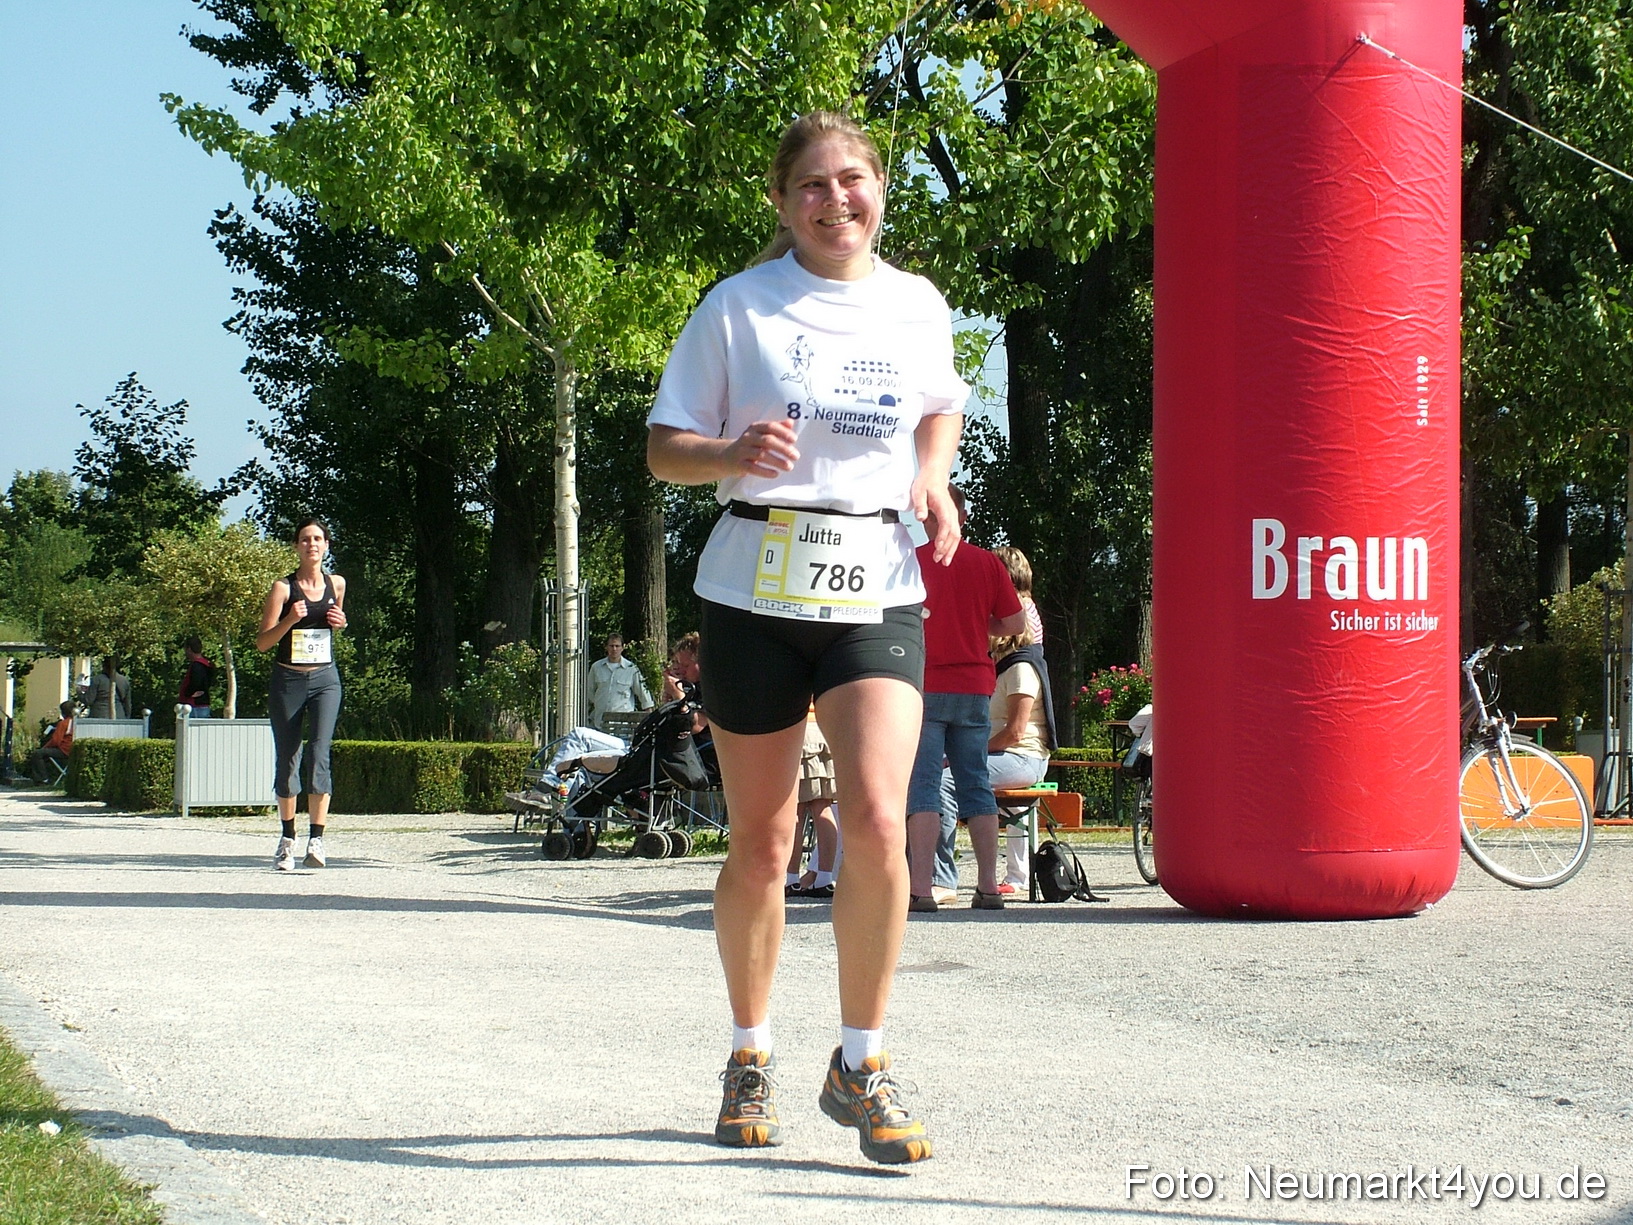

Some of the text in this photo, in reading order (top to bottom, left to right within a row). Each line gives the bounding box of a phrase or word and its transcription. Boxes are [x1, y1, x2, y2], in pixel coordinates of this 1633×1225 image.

[1416, 355, 1429, 392] 1929
[786, 402, 900, 426] 8. Neumarkter
[831, 421, 898, 439] Stadtlauf
[798, 523, 842, 546] Jutta
[765, 549, 774, 564] D
[1252, 518, 1428, 600] Braun
[809, 562, 866, 592] 786
[753, 598, 803, 613] BOCK
[1330, 609, 1439, 630] Sicher ist sicher
